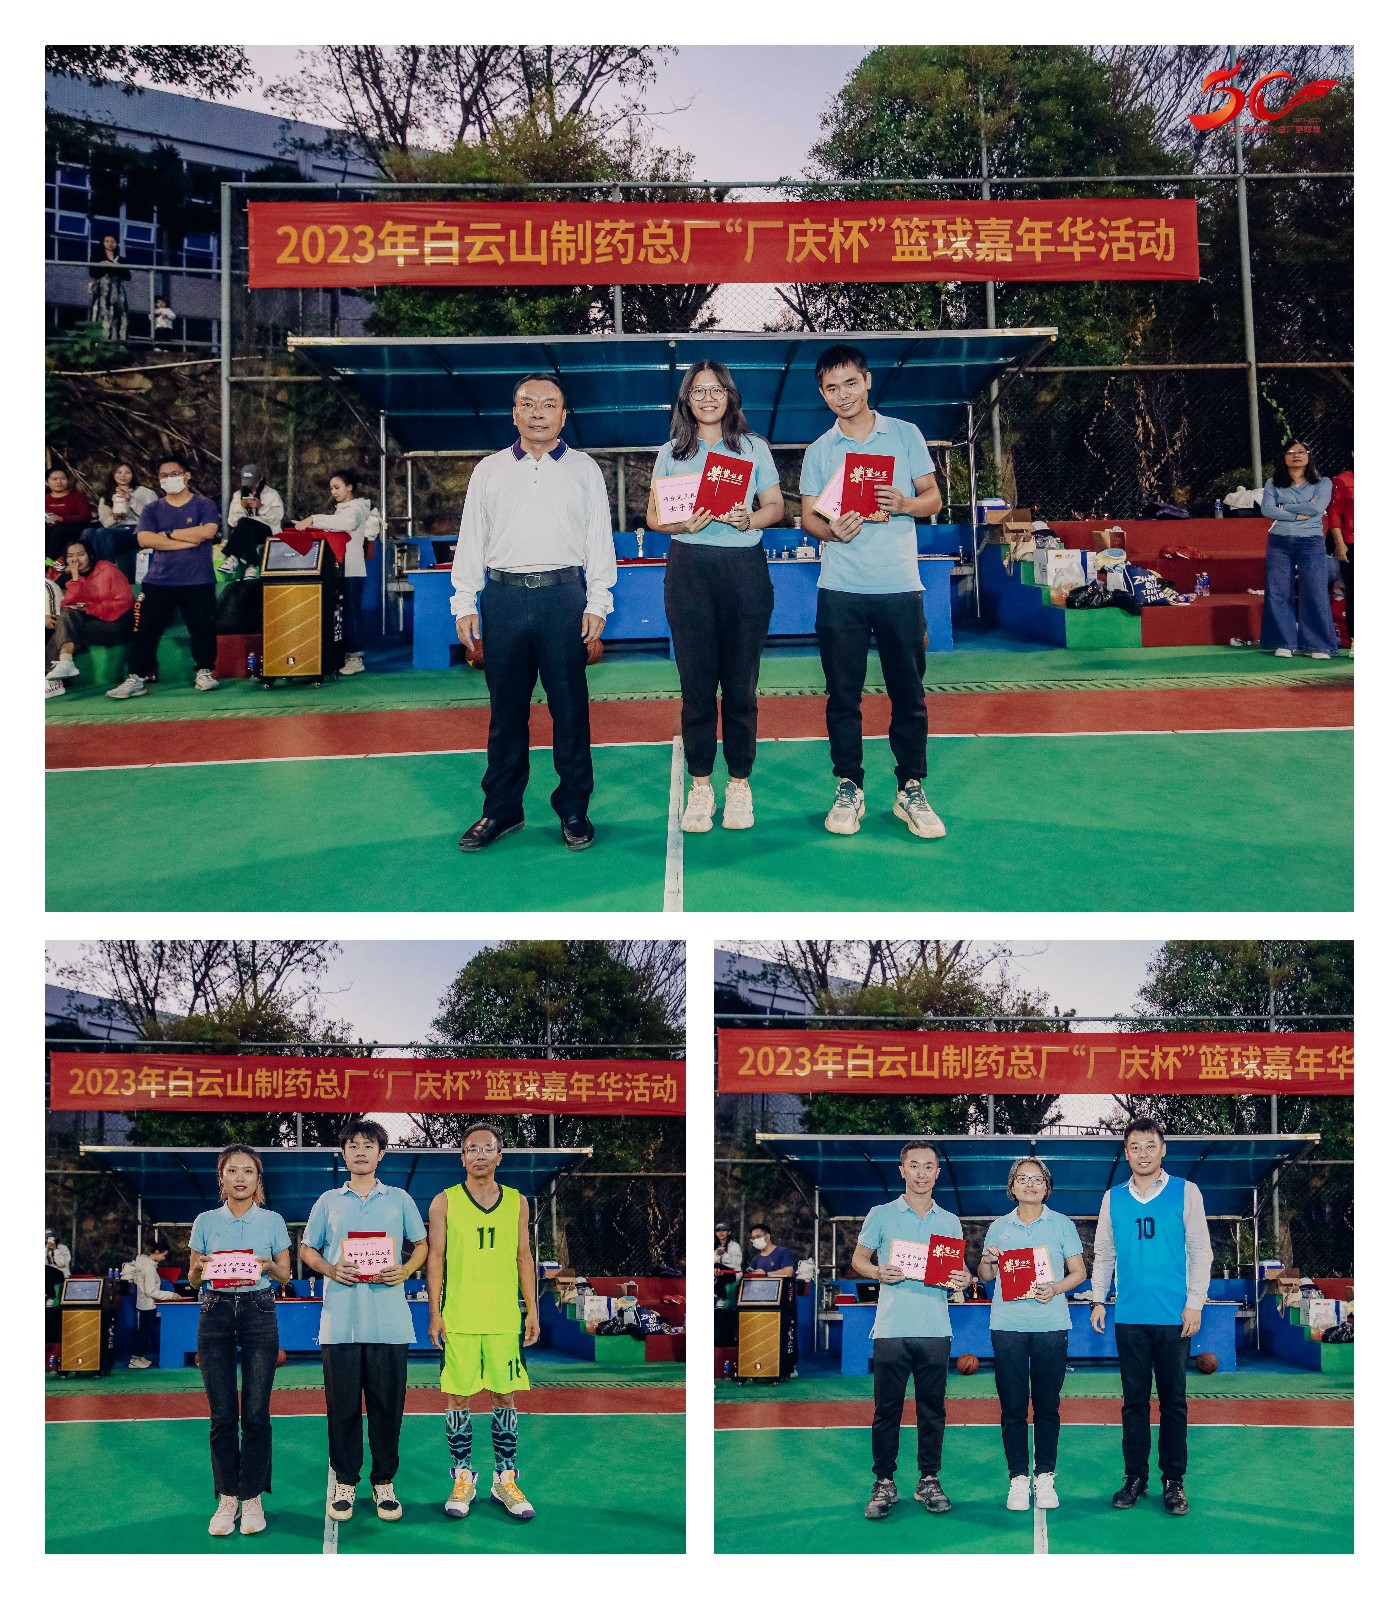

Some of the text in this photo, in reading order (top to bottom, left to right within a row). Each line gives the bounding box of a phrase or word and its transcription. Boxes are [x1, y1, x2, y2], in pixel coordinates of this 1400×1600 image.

[276, 218, 1176, 267] 2023年白云山制药总厂“厂庆杯”篮球嘉年华活动
[69, 1067, 678, 1104] 2023年白云山制药总厂“厂庆杯”篮球嘉年华活动
[477, 1227, 495, 1250] 11
[1135, 1217, 1156, 1240] 10
